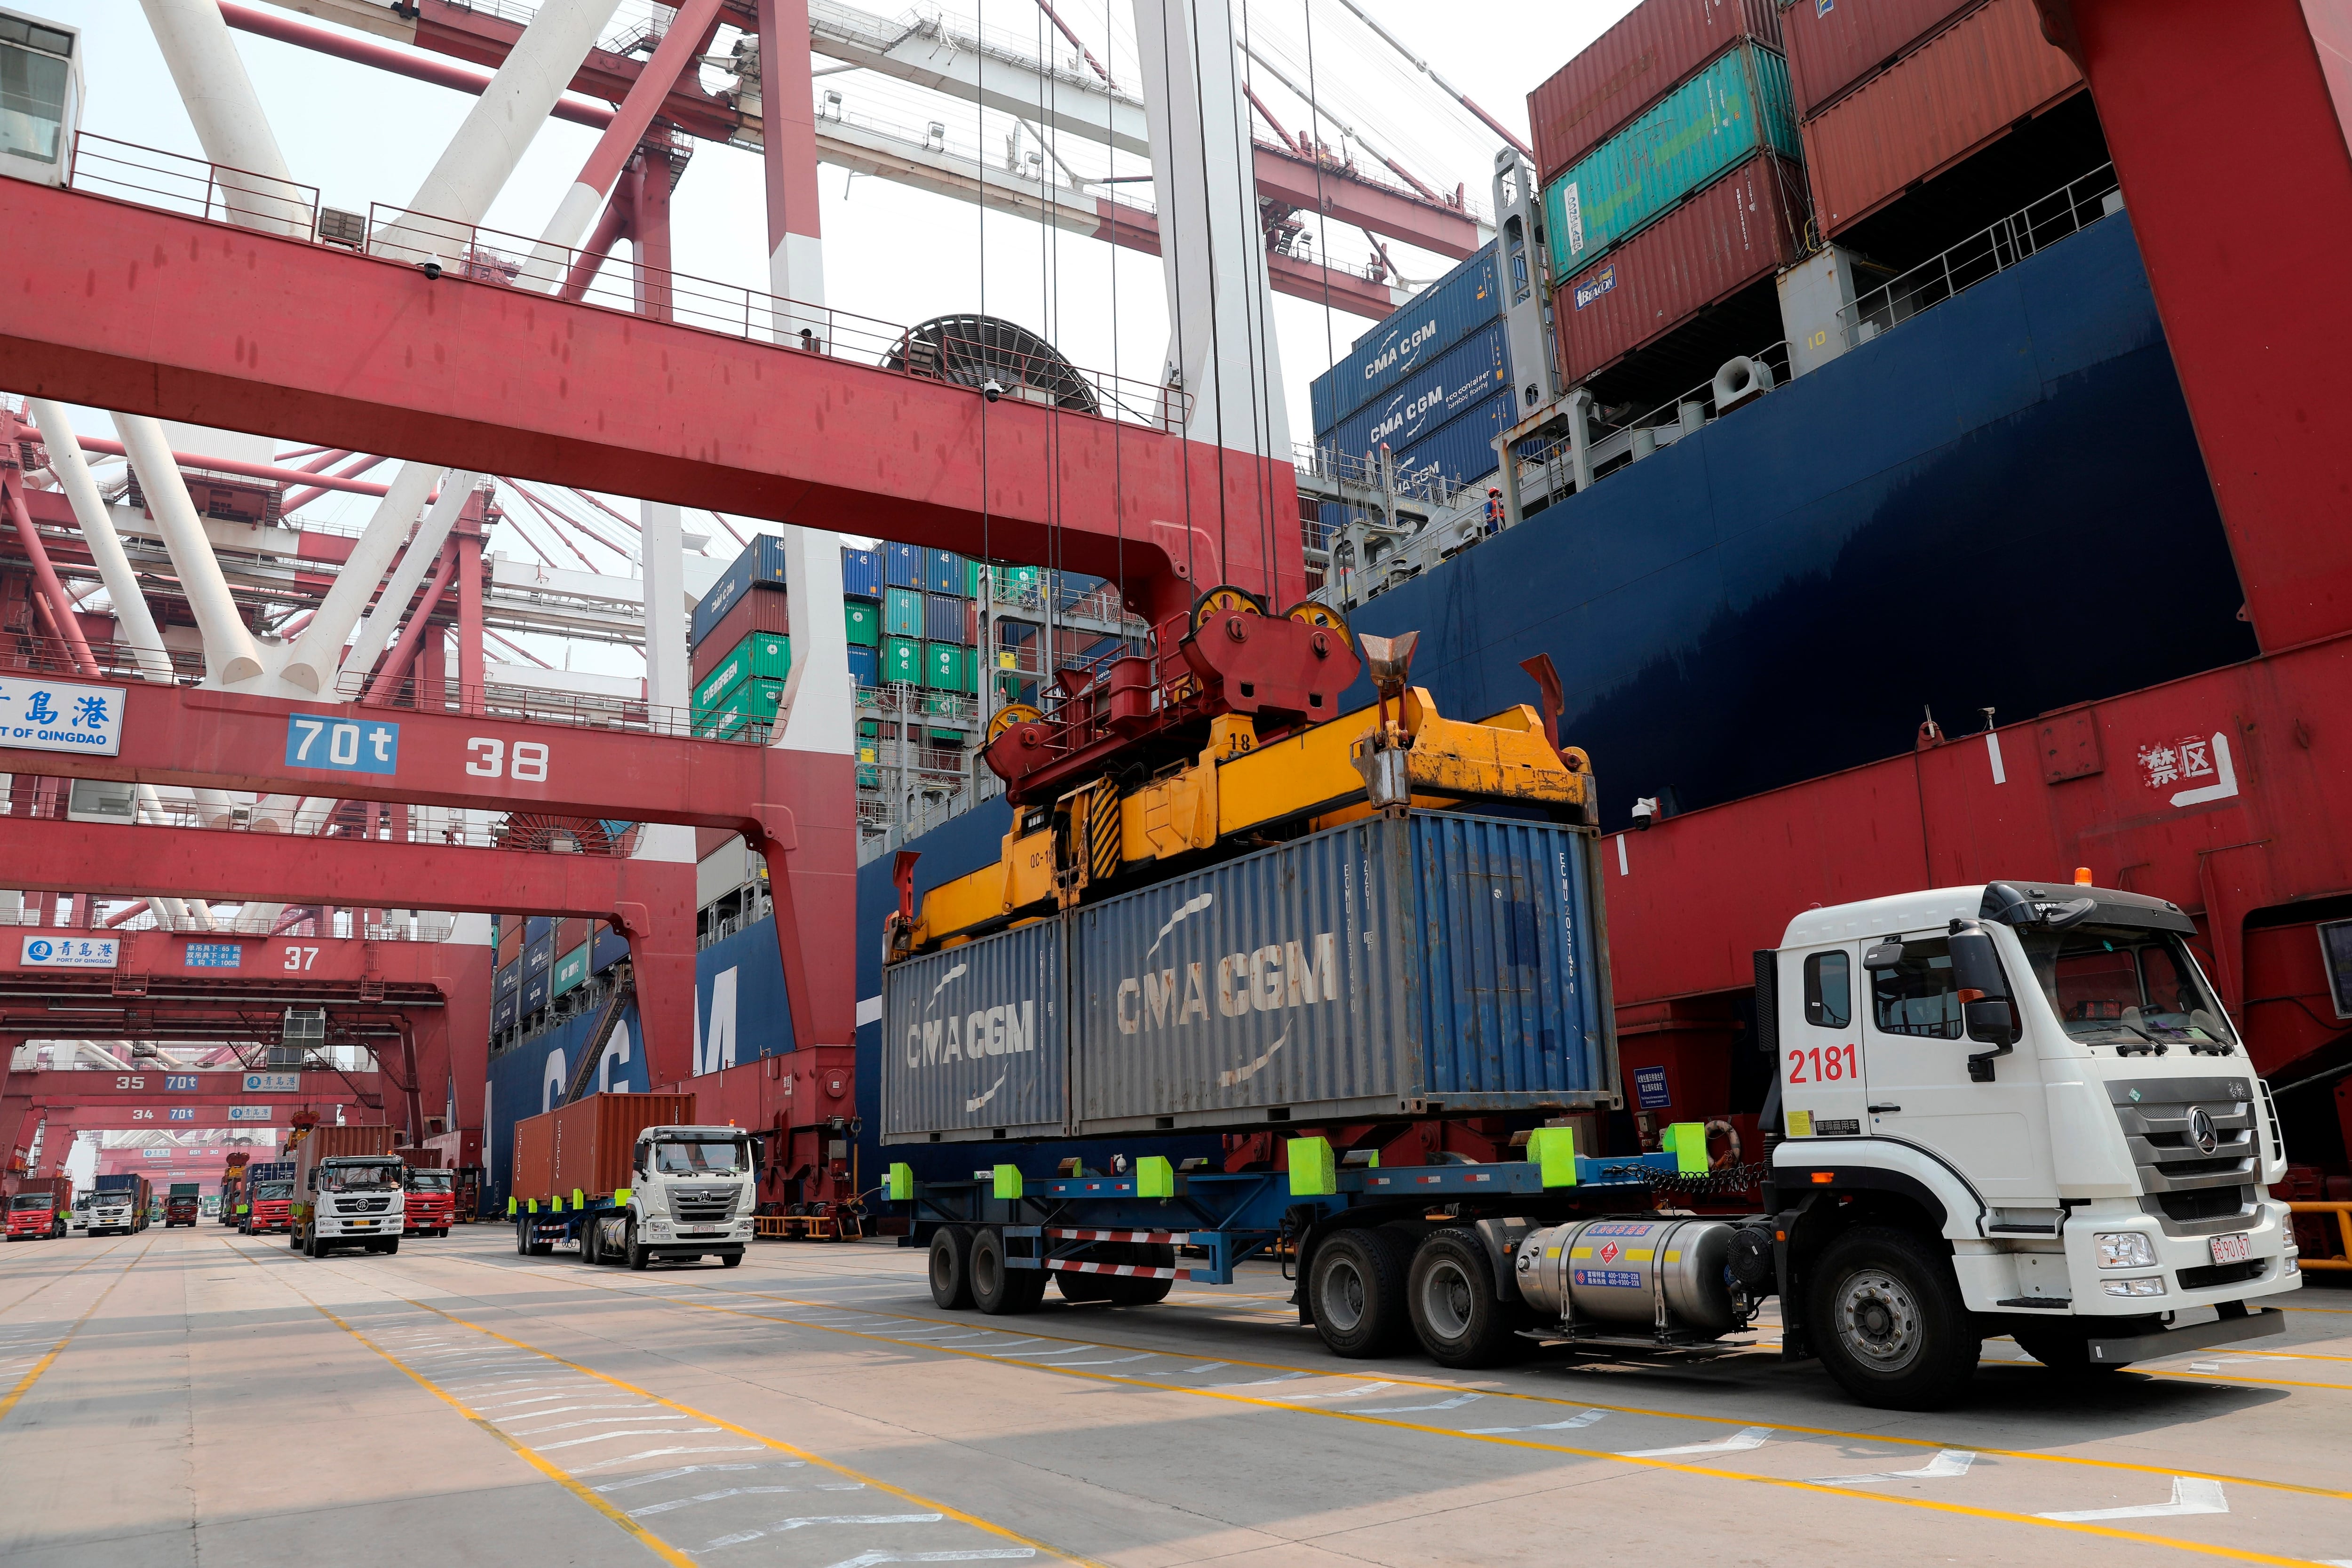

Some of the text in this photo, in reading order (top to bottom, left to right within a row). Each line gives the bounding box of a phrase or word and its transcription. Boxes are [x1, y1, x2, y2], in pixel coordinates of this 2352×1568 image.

[1581, 276, 1613, 304] BEACON
[1365, 319, 1436, 380] CMA CGM
[1809, 331, 1826, 350] 10
[1448, 381, 1488, 410] bamboo flooring
[1371, 370, 1490, 443] CMA CGM eco container
[1399, 501, 1423, 513] 2M(S)
[775, 541, 784, 550] 45
[901, 547, 909, 557] 45
[859, 555, 867, 565] 45
[940, 553, 950, 563] 45
[1376, 565, 1387, 578] 14
[901, 598, 909, 608] 45
[900, 660, 908, 669] 45
[940, 665, 949, 675] 45
[703, 660, 738, 705] EVERGREEN
[13, 728, 34, 738] OF
[37, 730, 106, 745] QINGDAO
[295, 720, 393, 765] 70t
[1229, 732, 1250, 751] 18
[466, 737, 549, 782] 38
[2142, 740, 2214, 786] 禁区
[1559, 852, 1568, 902] ECMU
[1565, 905, 1573, 978] 203746
[284, 947, 319, 971] 37
[1117, 932, 1337, 1035] CMA CGM
[907, 1000, 1034, 1068] CMA CGM
[1788, 1044, 1857, 1084] 2181
[116, 1076, 145, 1089] 35
[167, 1076, 197, 1090] 70t
[133, 1109, 154, 1119] 34
[171, 1108, 193, 1119] 70t
[2223, 1238, 2250, 1258] 90187
